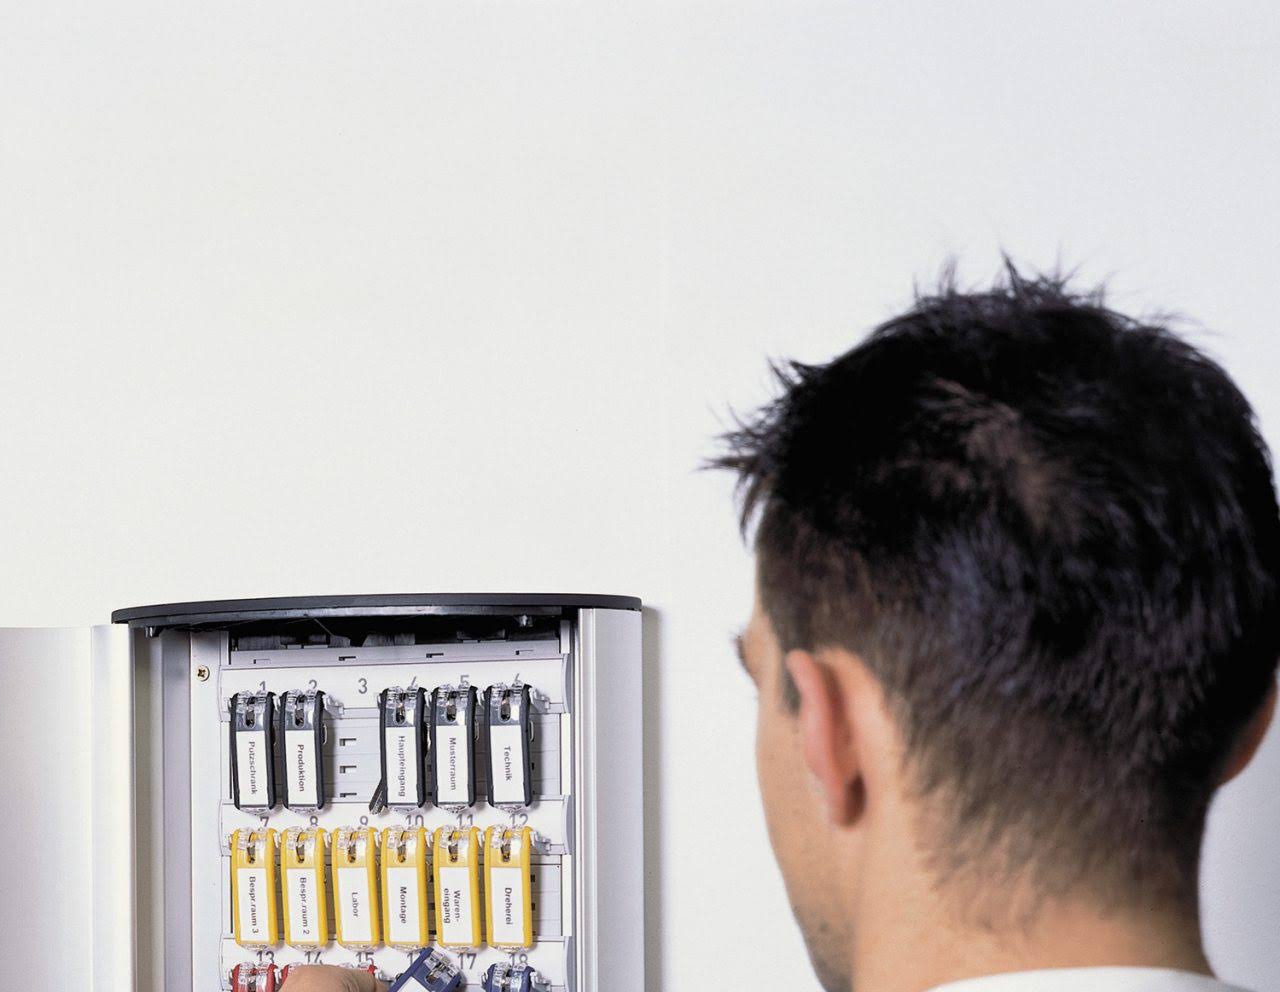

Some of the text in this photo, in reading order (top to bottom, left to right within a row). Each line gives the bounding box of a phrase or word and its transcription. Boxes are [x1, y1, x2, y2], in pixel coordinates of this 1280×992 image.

[357, 677, 368, 695] 3
[248, 741, 258, 795] Putzschrank
[297, 744, 305, 792] Produktion
[398, 735, 406, 797] Haupteingang
[449, 737, 457, 791] Musterraum
[504, 745, 512, 781] Technik
[248, 876, 258, 927] Bespr.raum
[299, 877, 309, 928] Bespr.raum
[351, 892, 359, 917] Labor
[398, 886, 407, 924] Montage
[443, 888, 451, 924] eingang
[453, 889, 461, 922] Waren-
[504, 887, 513, 925] Dreherei
[355, 951, 375, 966] 15
[457, 952, 477, 970] 17
